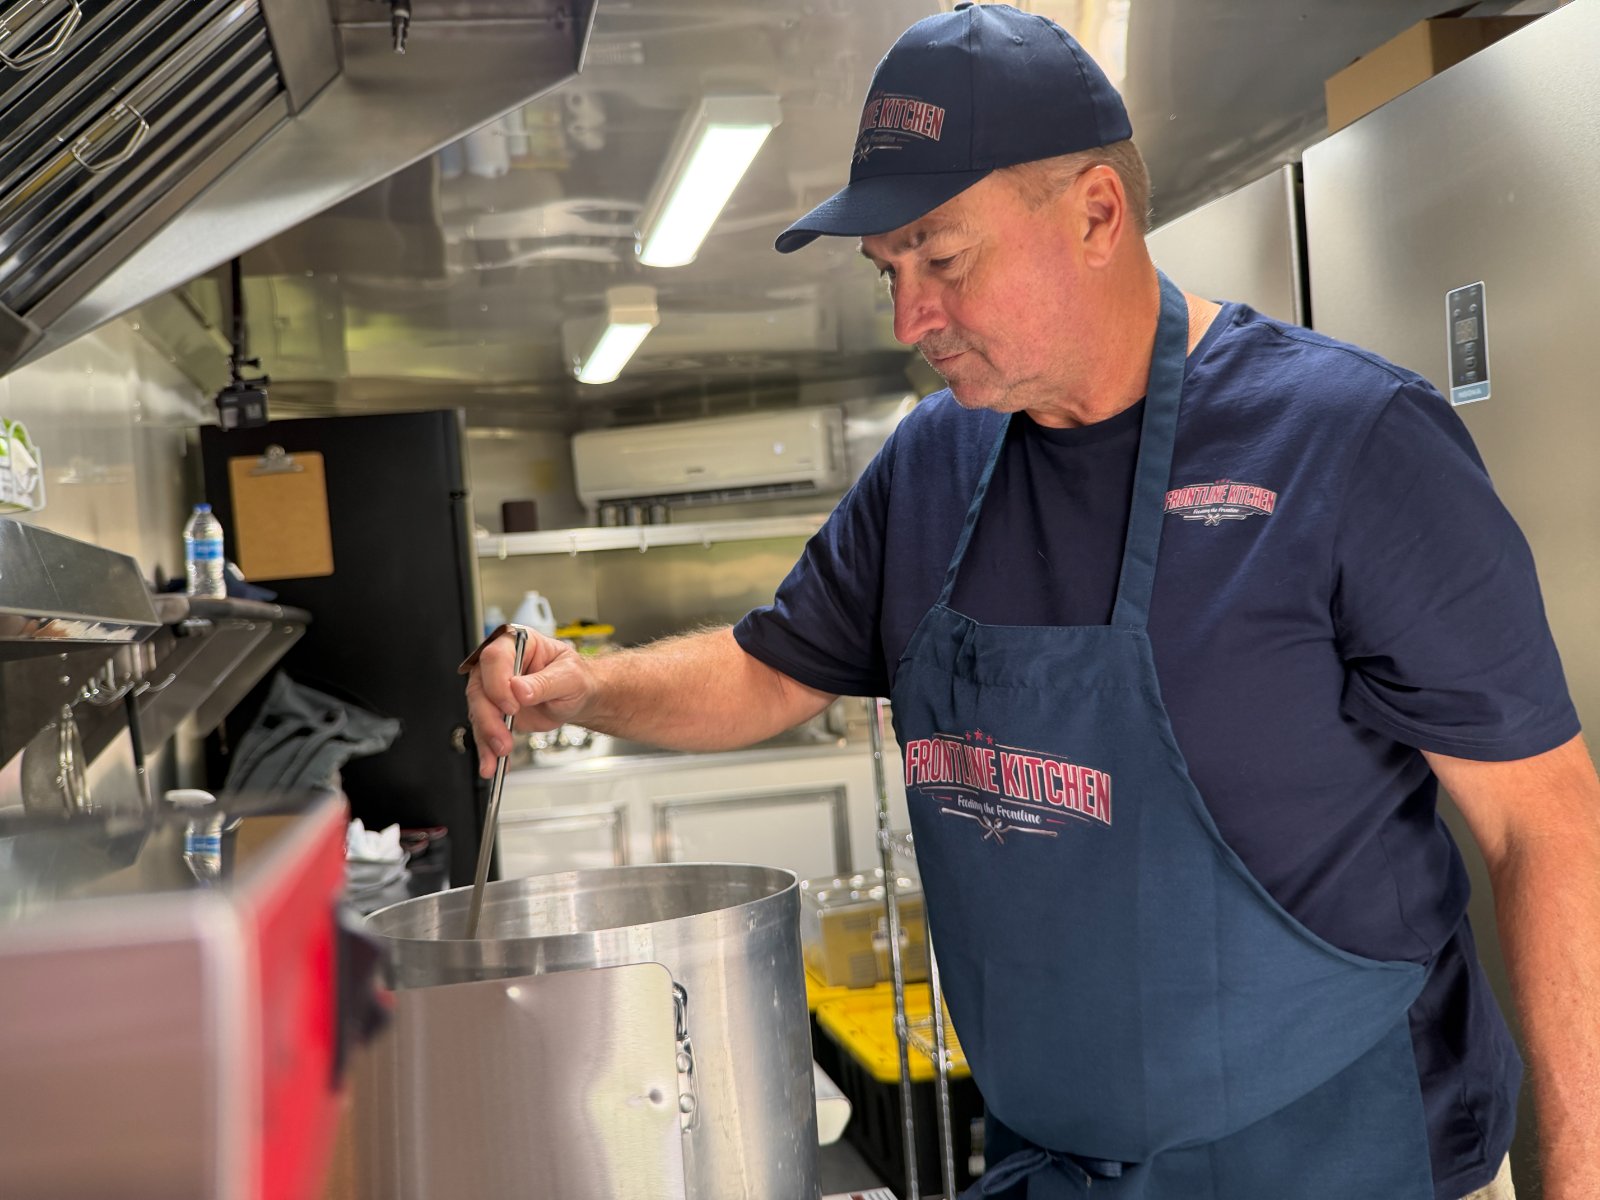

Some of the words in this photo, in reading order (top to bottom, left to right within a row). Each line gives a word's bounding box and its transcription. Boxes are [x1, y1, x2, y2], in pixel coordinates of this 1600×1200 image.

[878, 98, 945, 142] KITCHEN
[1164, 484, 1229, 511] FRONTLINE
[1227, 484, 1277, 514] KITCHEN
[905, 738, 999, 794] FRONTLINE
[999, 751, 1112, 826] KITCHEN
[984, 802, 995, 815] the
[996, 804, 1041, 824] Frontline
